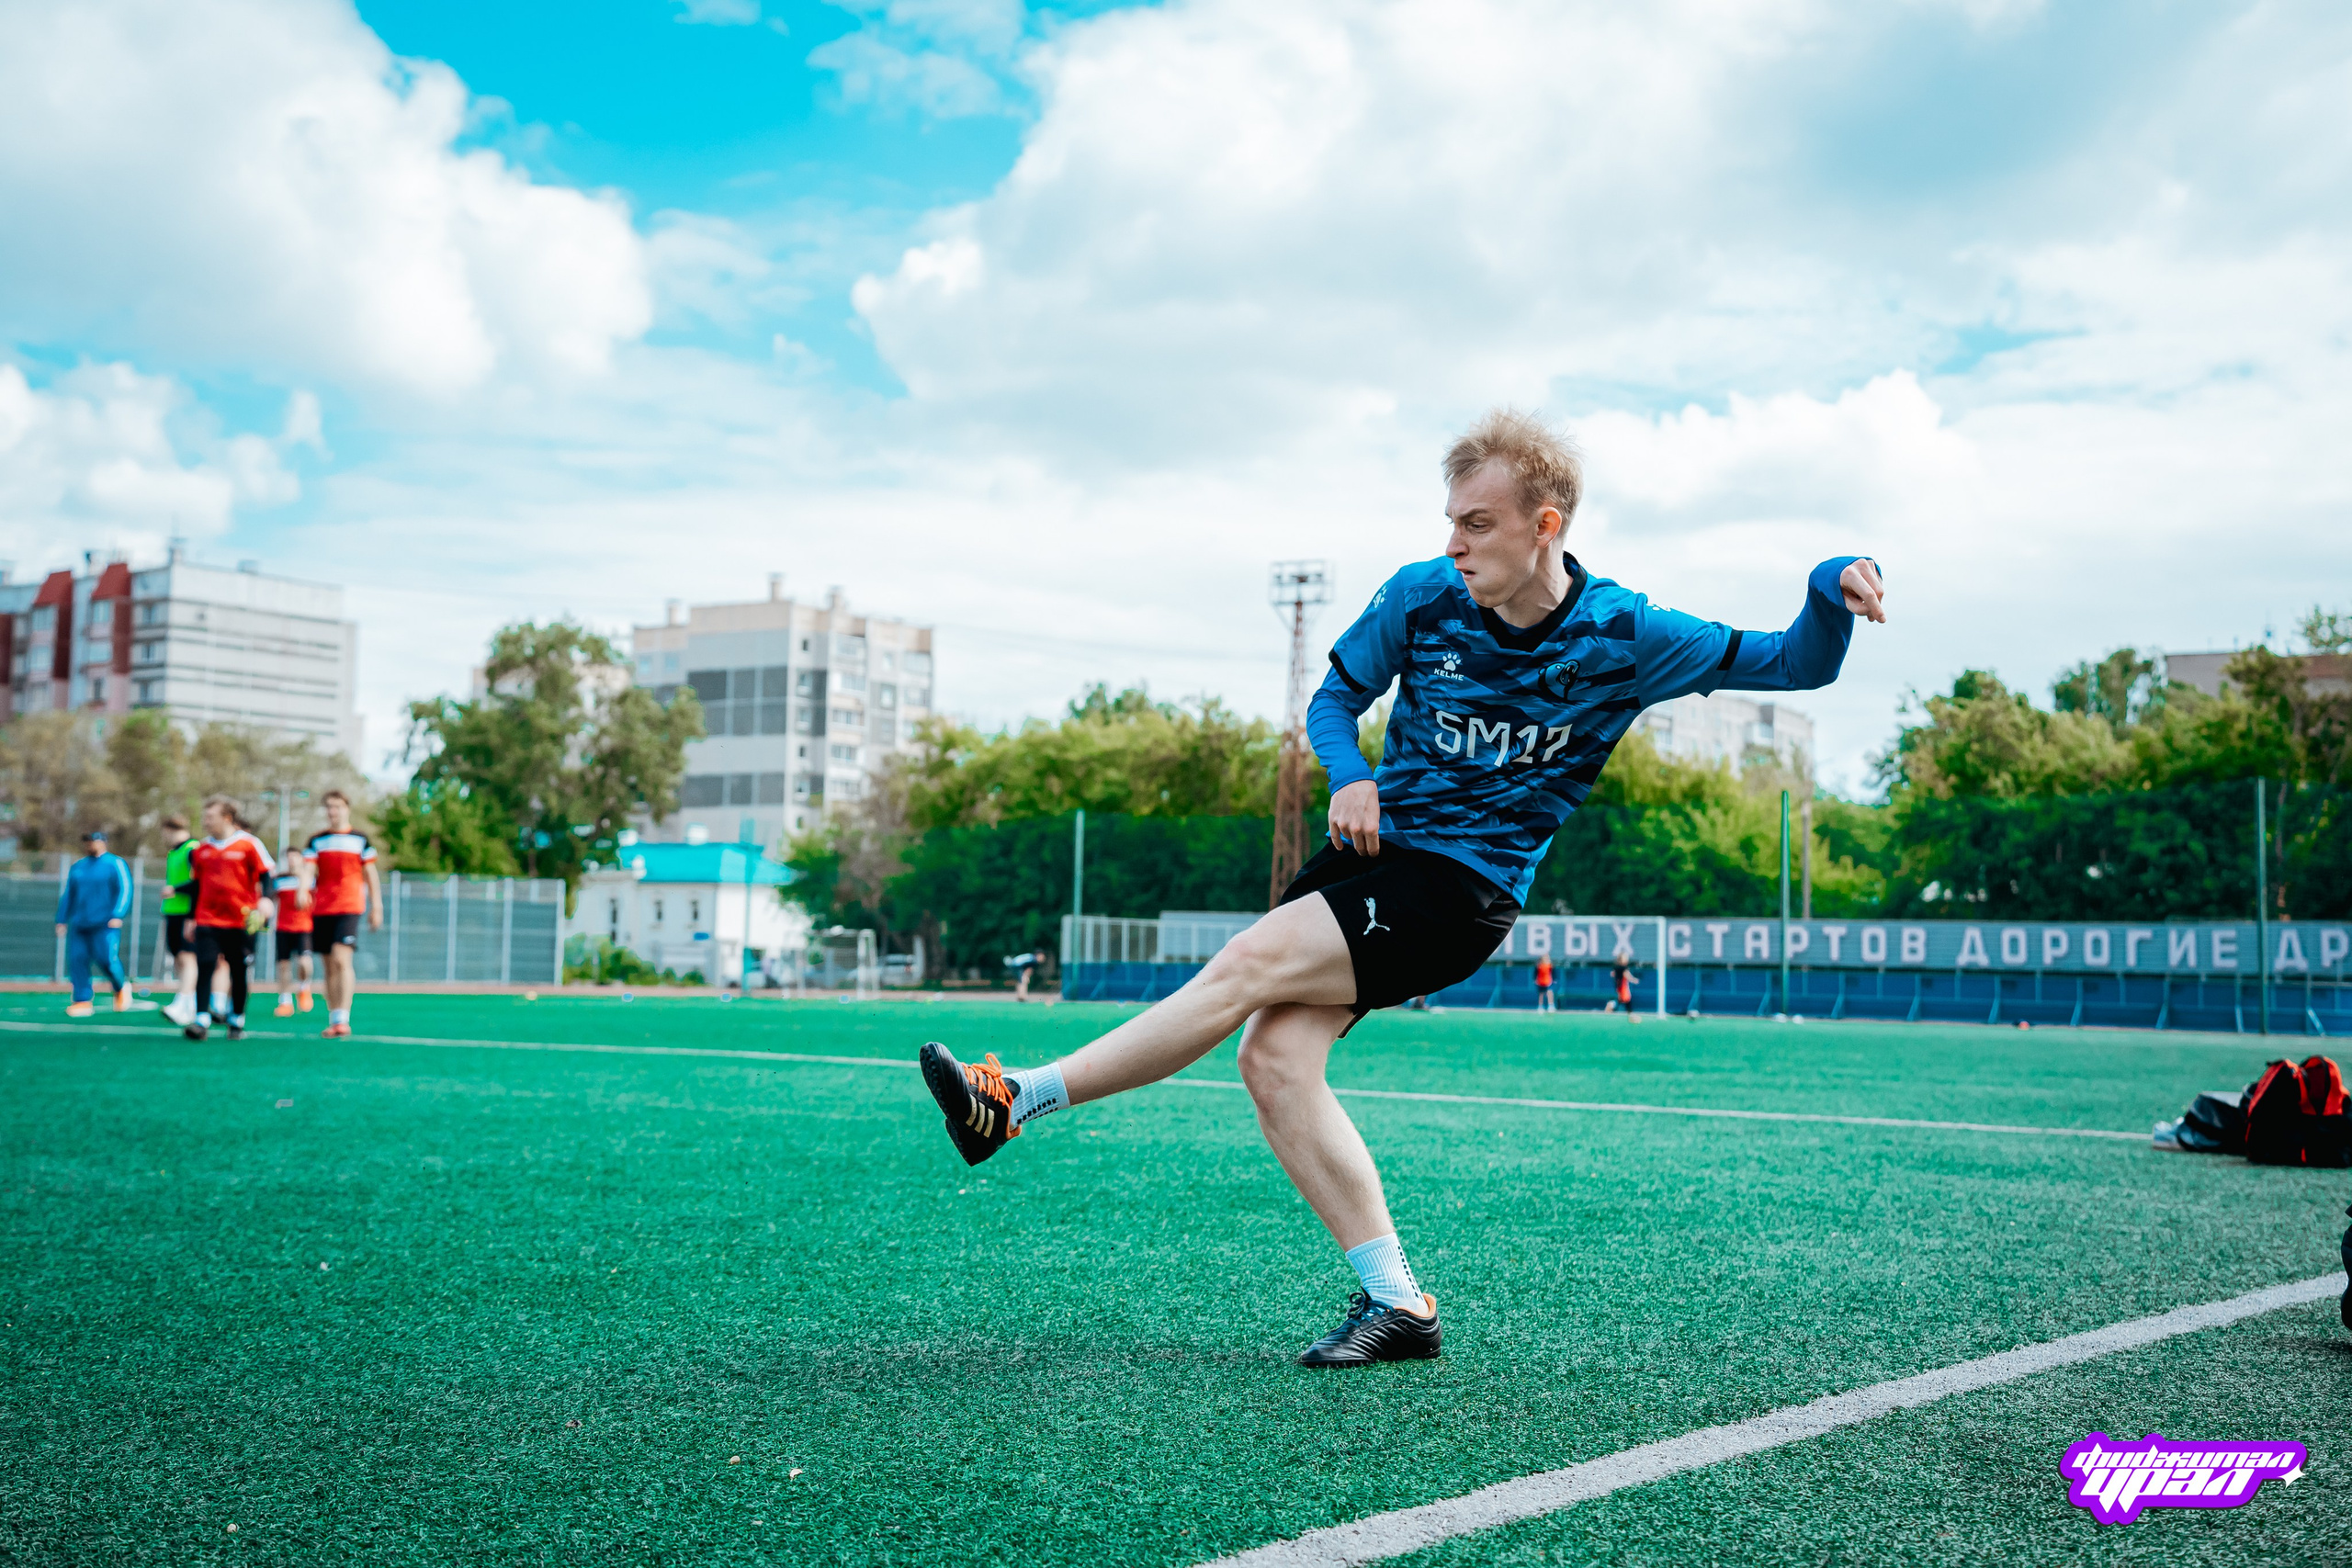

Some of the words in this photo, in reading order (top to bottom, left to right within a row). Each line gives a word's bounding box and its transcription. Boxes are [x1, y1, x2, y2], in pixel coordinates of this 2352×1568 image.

[1433, 667, 1464, 682] KELME
[1434, 710, 1573, 768] SM17
[1668, 923, 1927, 963] СТАРТОВ
[1956, 926, 2239, 968] ДОРОГИЕ
[2274, 928, 2349, 971] ДР
